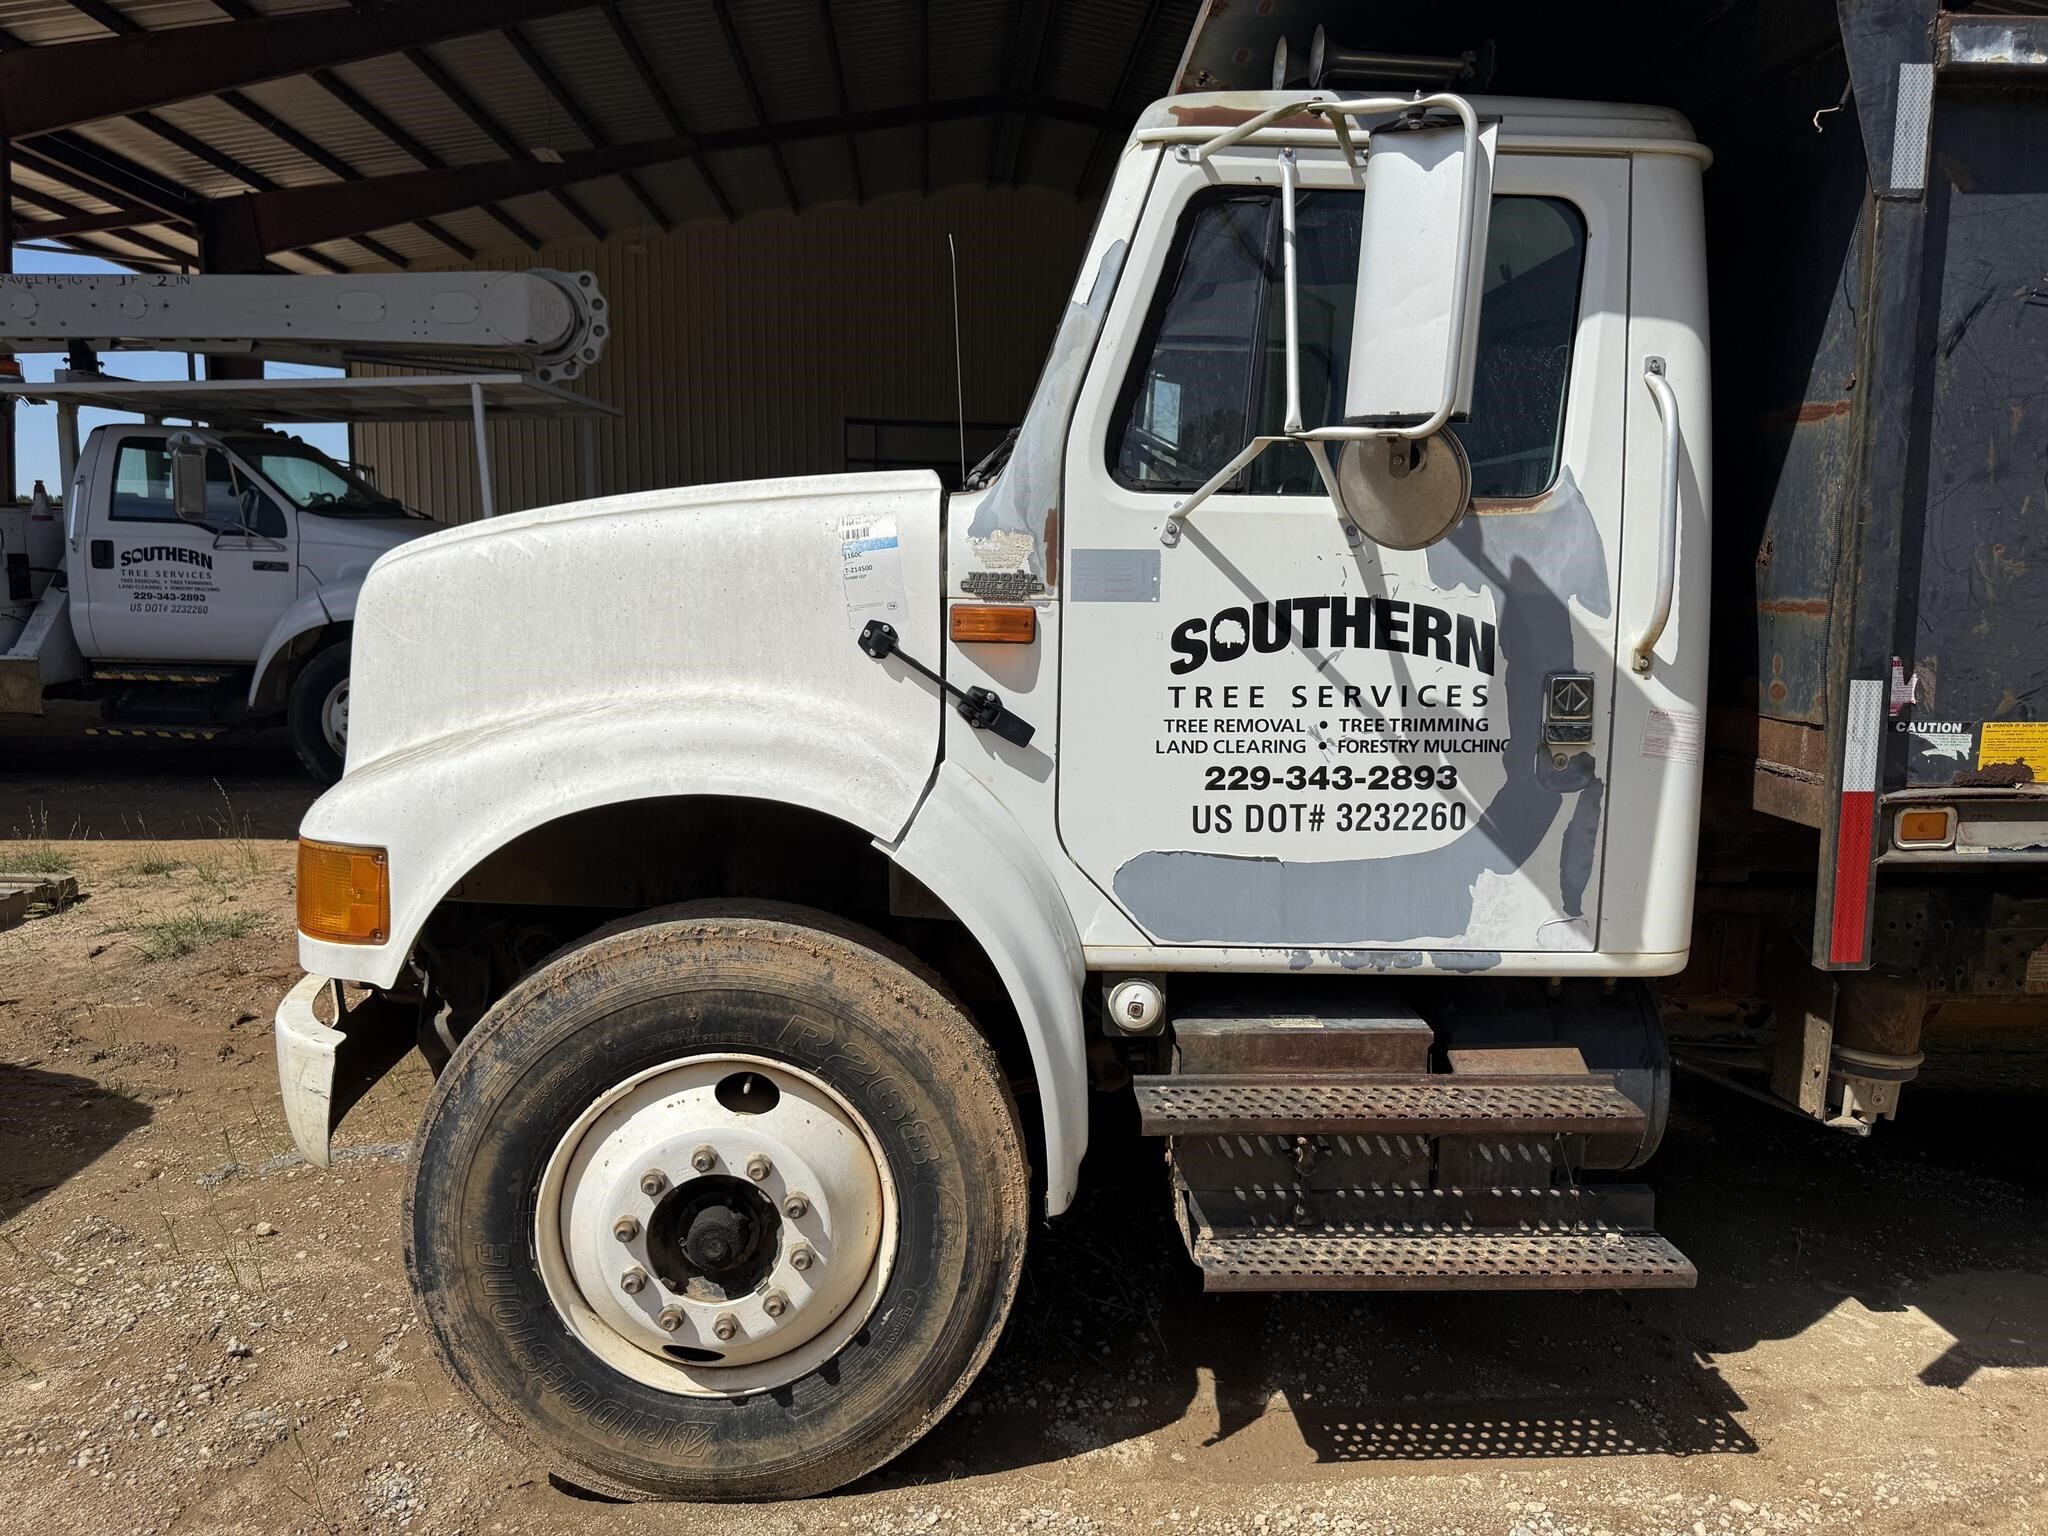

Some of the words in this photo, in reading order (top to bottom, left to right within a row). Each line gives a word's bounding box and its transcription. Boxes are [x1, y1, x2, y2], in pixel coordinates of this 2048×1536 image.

[120, 546, 213, 571] SOUTHERN
[120, 569, 149, 578] TREE
[155, 570, 212, 579] SERVICES
[133, 591, 206, 602] 229-343-2893
[130, 603, 143, 613] US
[145, 603, 169, 613] DOT#
[170, 604, 209, 615] 3232260
[1171, 595, 1495, 676] SOUTHERN
[1168, 686, 1264, 708] TREE
[1293, 684, 1488, 708] SERVICES
[1164, 719, 1208, 733] TREE
[1215, 718, 1306, 733] REMOVAL
[1339, 718, 1385, 733] TREE
[1390, 718, 1489, 733] TRIMMING
[1896, 722, 1963, 733] CAUTION
[1156, 740, 1208, 754] LAND
[1214, 739, 1306, 754] CLEARING
[1338, 739, 1420, 754] FORESTRY
[1204, 765, 1458, 791] 229-343-2893
[1193, 804, 1232, 834] US
[1246, 803, 1325, 833] DOT#
[1337, 801, 1466, 832] 3232260
[776, 1014, 942, 1164] R268
[473, 1241, 720, 1458] BRIDGESTONE
